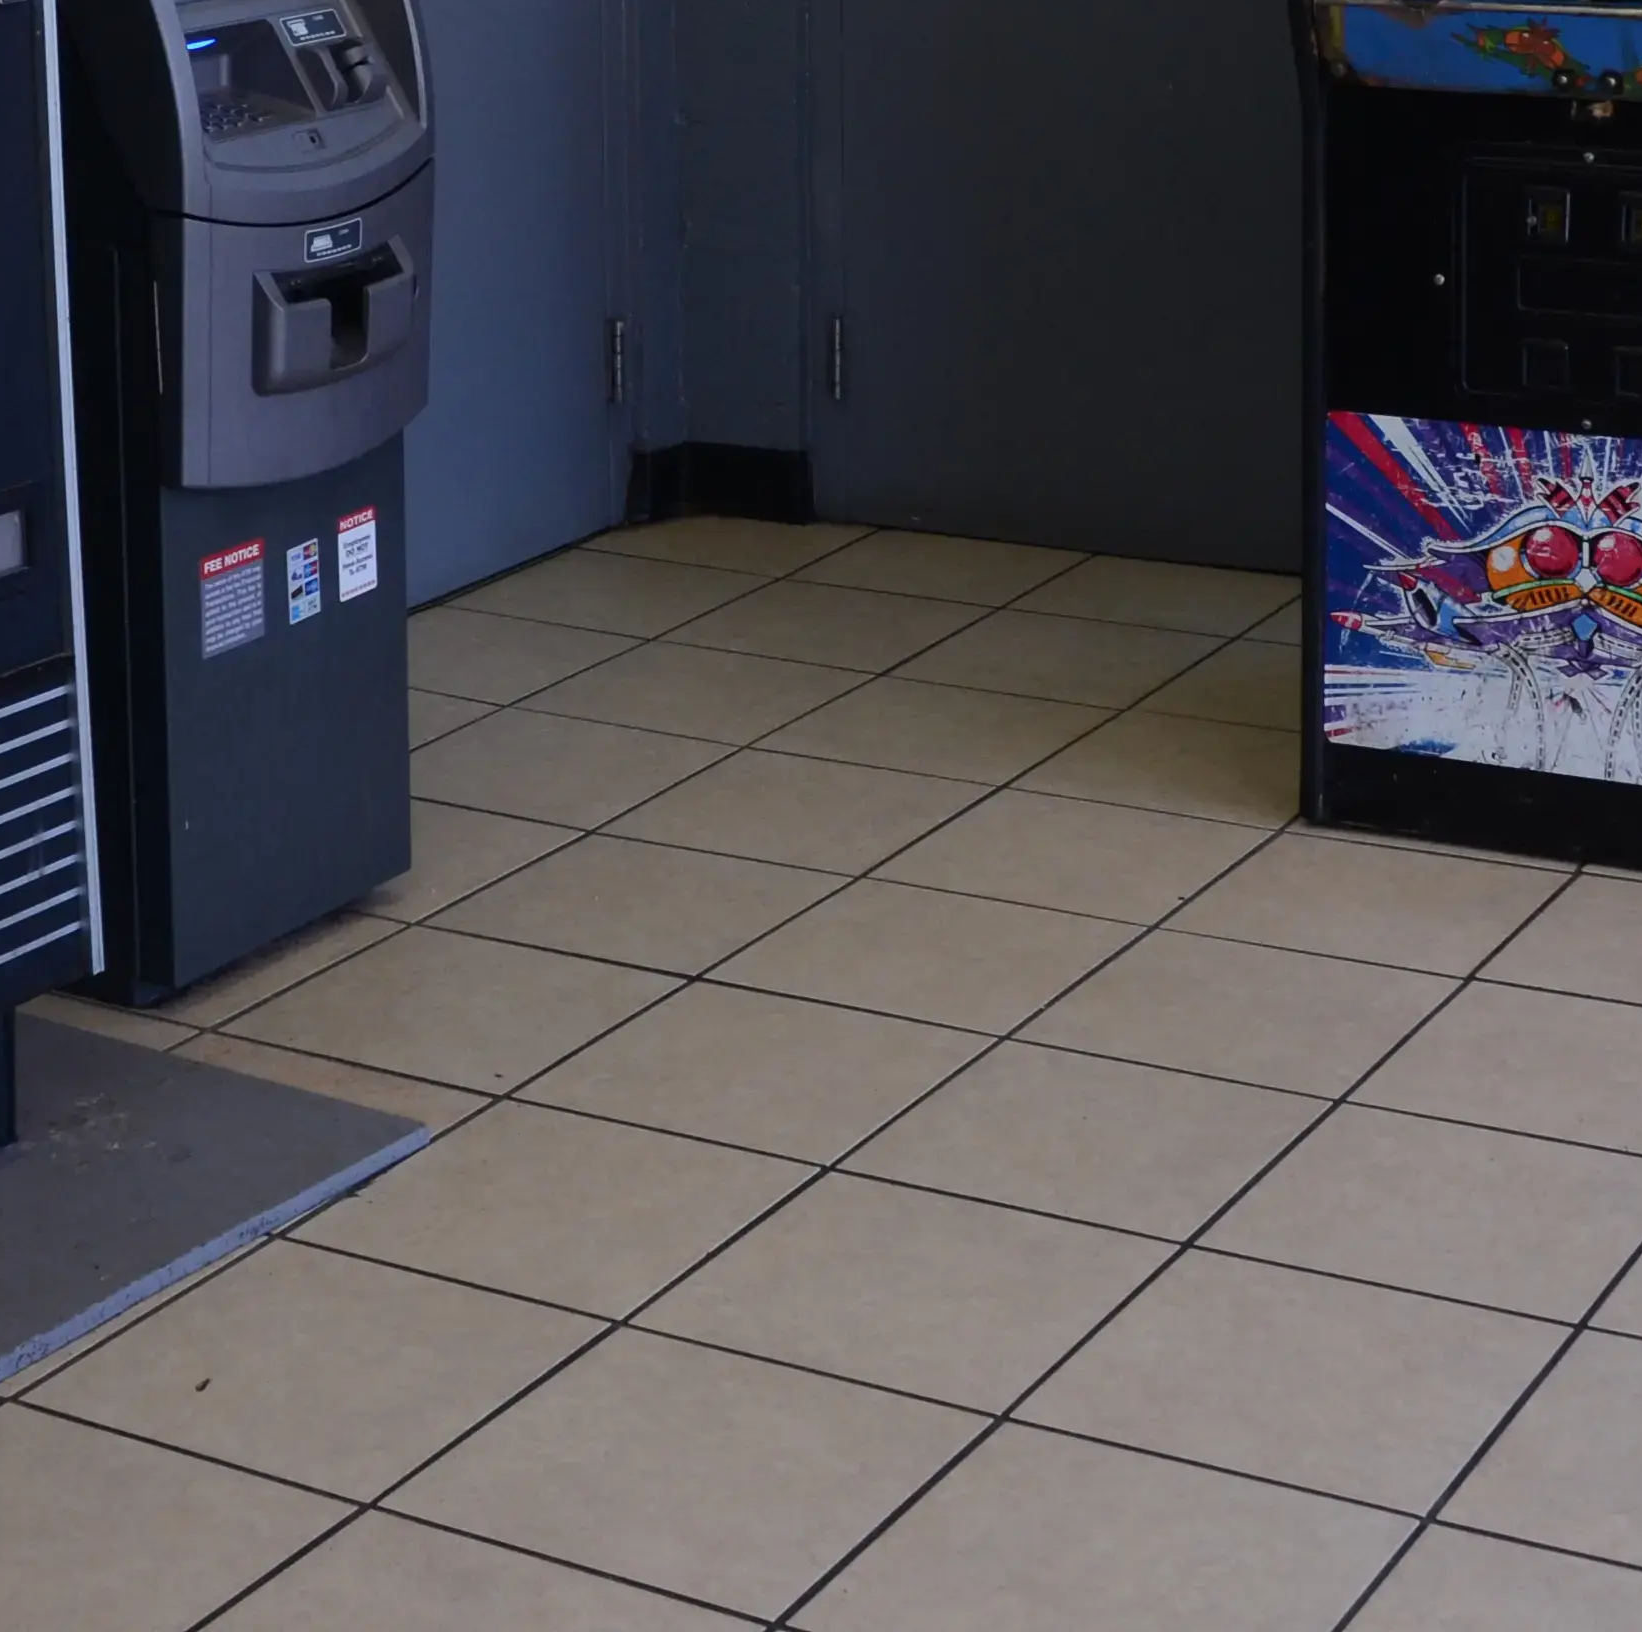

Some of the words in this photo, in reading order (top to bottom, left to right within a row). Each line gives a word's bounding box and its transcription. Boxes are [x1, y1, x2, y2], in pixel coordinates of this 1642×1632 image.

[339, 509, 374, 531] NOTICE
[204, 557, 223, 574] FEE
[224, 543, 261, 567] NOTICE
